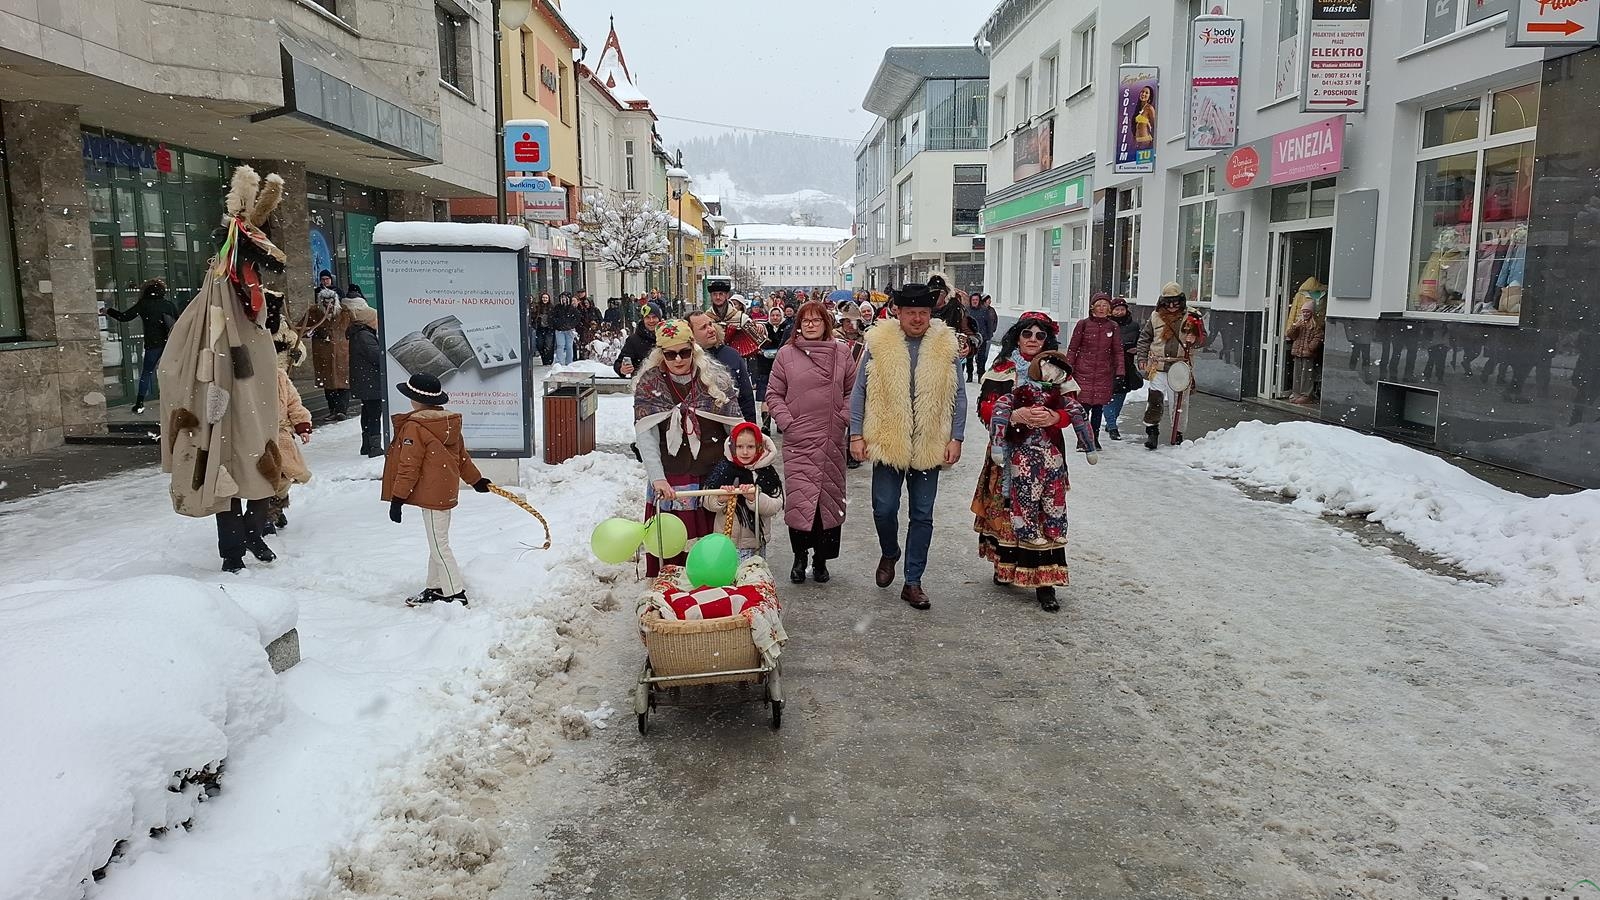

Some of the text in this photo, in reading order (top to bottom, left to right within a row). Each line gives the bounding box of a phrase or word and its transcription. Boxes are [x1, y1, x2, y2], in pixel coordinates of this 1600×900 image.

[1323, 4, 1358, 13] nástrek
[1213, 28, 1236, 37] body
[1212, 36, 1235, 44] activ
[1311, 48, 1364, 57] ELEKTRO
[1279, 128, 1333, 163] VENEZIA
[527, 199, 560, 207] NOVA
[408, 297, 433, 306] Andrej
